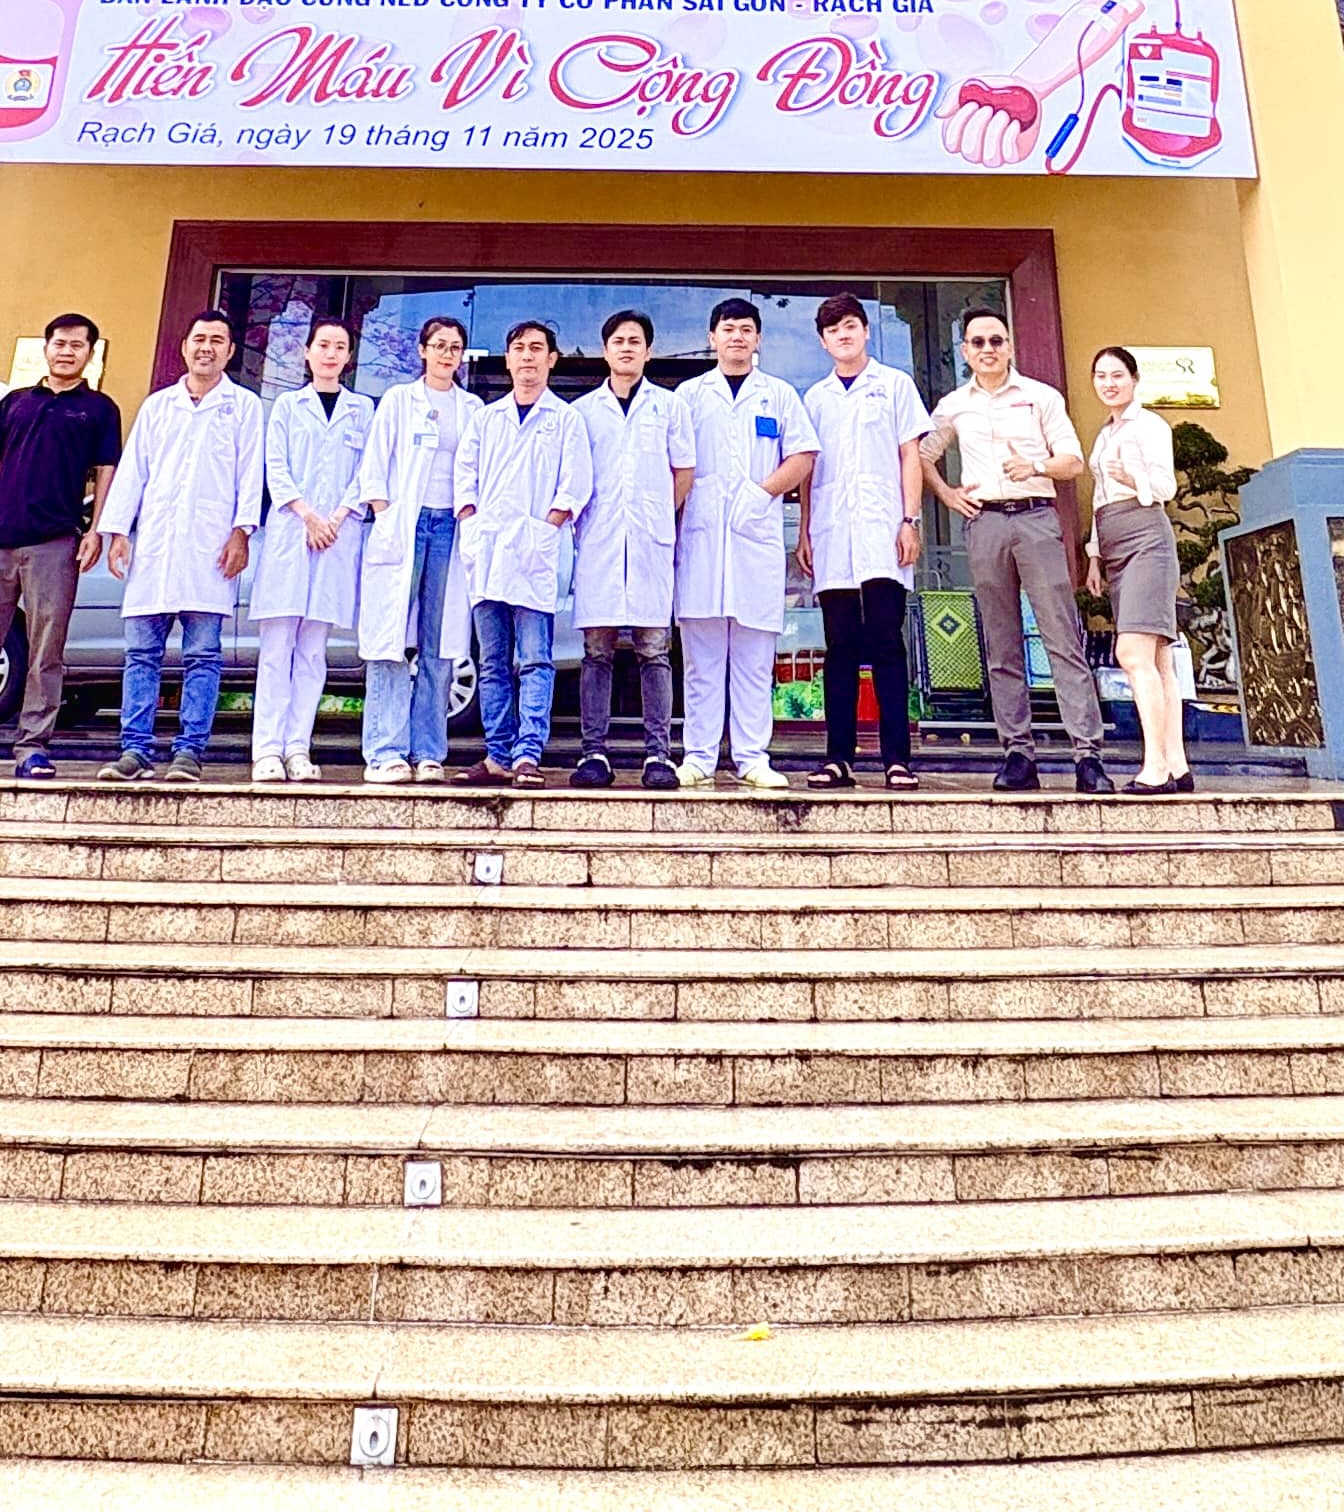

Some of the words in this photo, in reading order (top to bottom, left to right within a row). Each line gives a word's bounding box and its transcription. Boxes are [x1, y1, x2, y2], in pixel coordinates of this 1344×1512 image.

[86, 15, 214, 104] Hiến
[231, 25, 413, 107] Máu
[431, 28, 529, 110] Vì
[548, 35, 736, 136] Cộng
[757, 38, 937, 138] Đồng
[76, 121, 156, 148] Rạch
[167, 121, 223, 149] Giá,
[236, 122, 312, 151] ngày
[324, 123, 357, 146] 19
[365, 123, 450, 152] tháng
[463, 125, 492, 147] 11
[502, 126, 568, 149] năm
[578, 126, 655, 151] 2025
